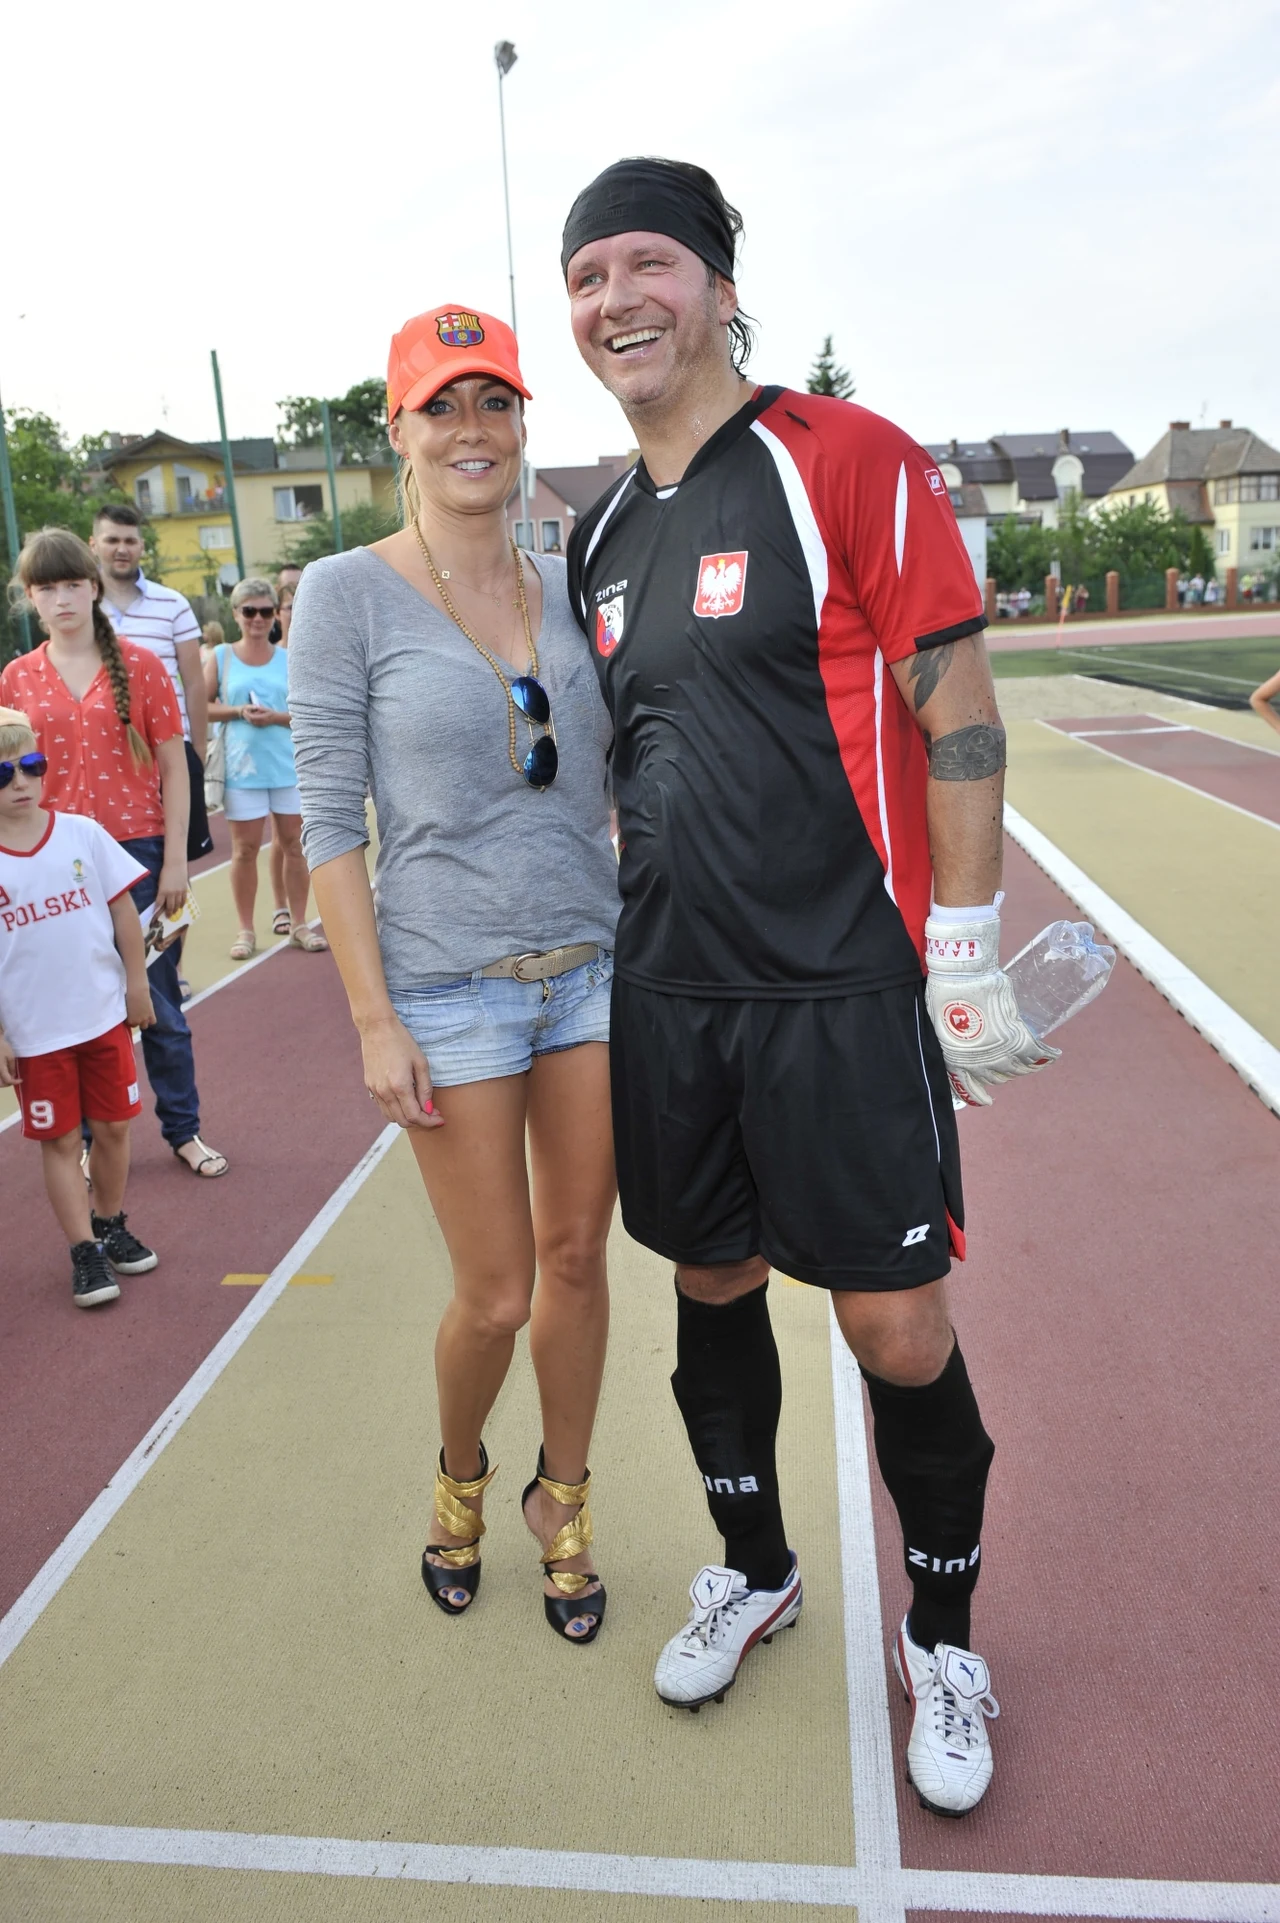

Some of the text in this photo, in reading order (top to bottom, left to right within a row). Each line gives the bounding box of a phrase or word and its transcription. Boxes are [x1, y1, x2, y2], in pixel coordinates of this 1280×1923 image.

[595, 579, 628, 603] zina
[1, 888, 91, 932] POLSKA
[30, 1099, 55, 1130] 9
[703, 1474, 759, 1494] ina
